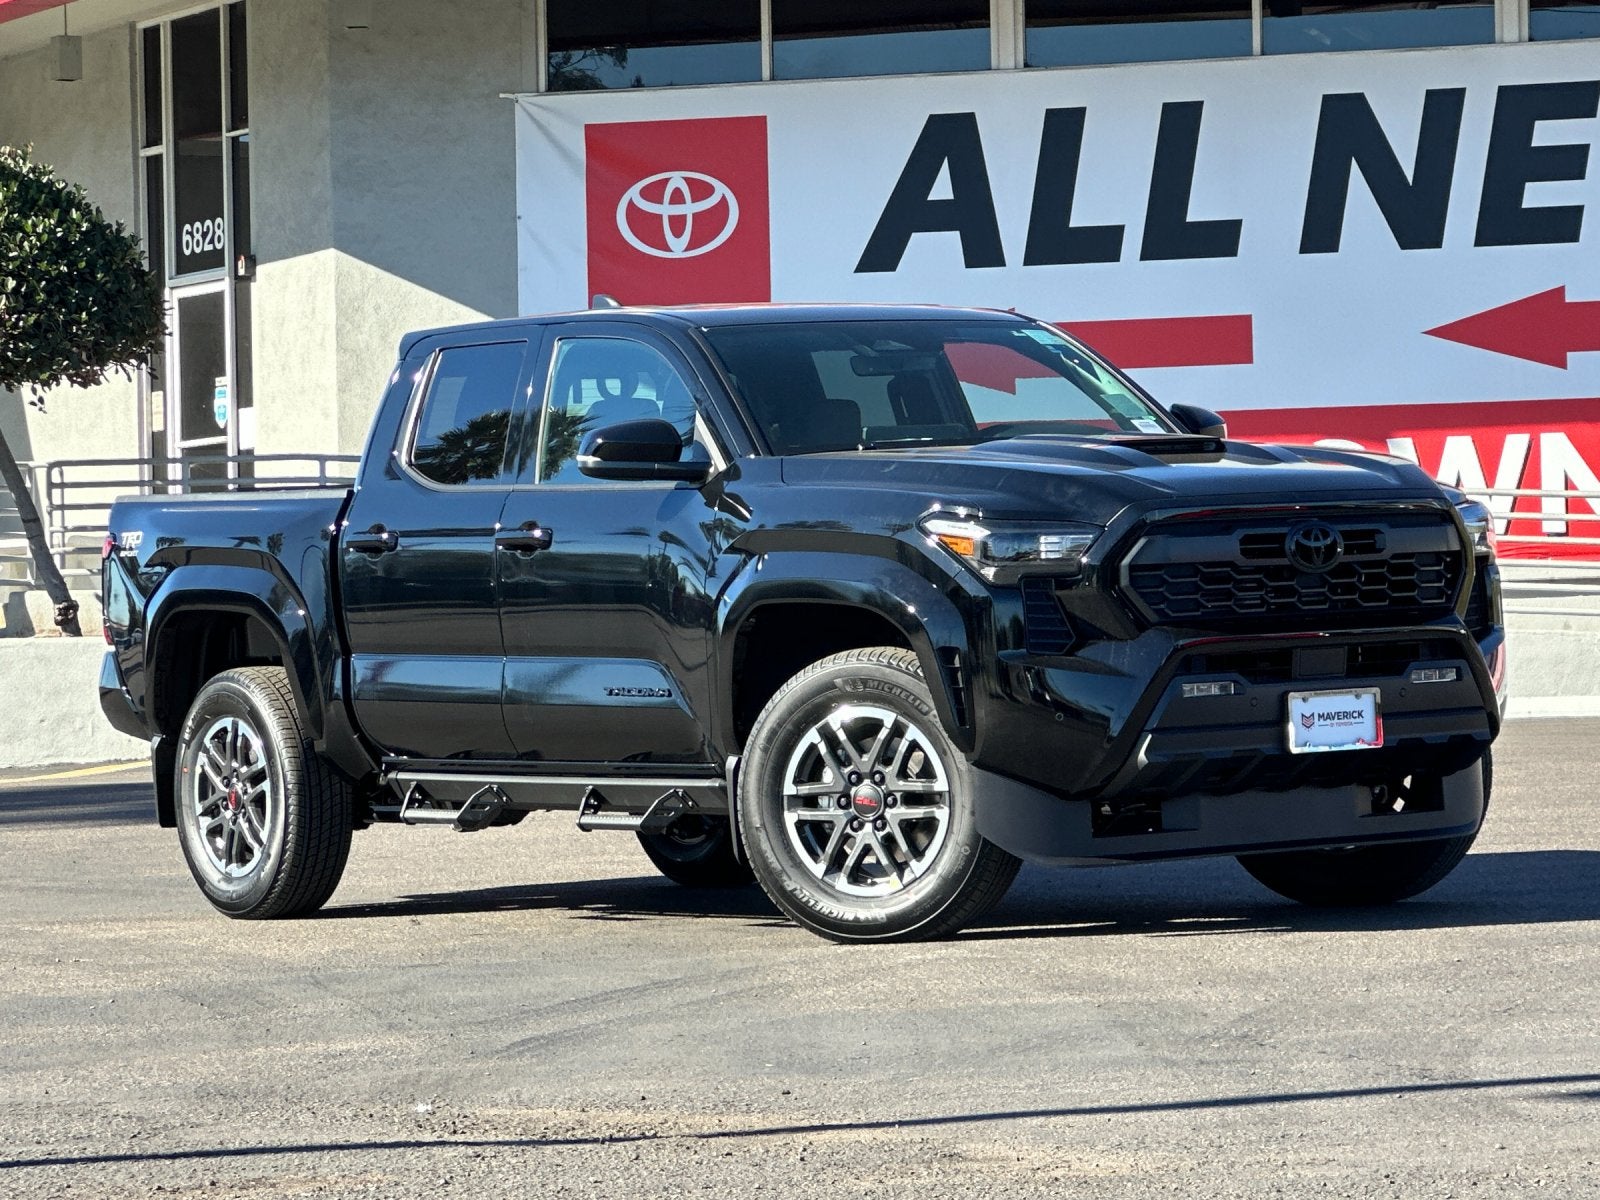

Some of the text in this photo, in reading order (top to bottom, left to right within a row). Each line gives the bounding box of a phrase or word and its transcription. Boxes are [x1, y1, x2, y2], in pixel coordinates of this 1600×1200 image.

[853, 100, 1243, 273] ALL
[182, 217, 224, 256] 6828
[1313, 432, 1600, 535] WN
[121, 531, 143, 549] TRD
[866, 679, 930, 714] MICHELIN
[1317, 709, 1364, 722] MAVERICK
[792, 888, 857, 922] MICHELIN
